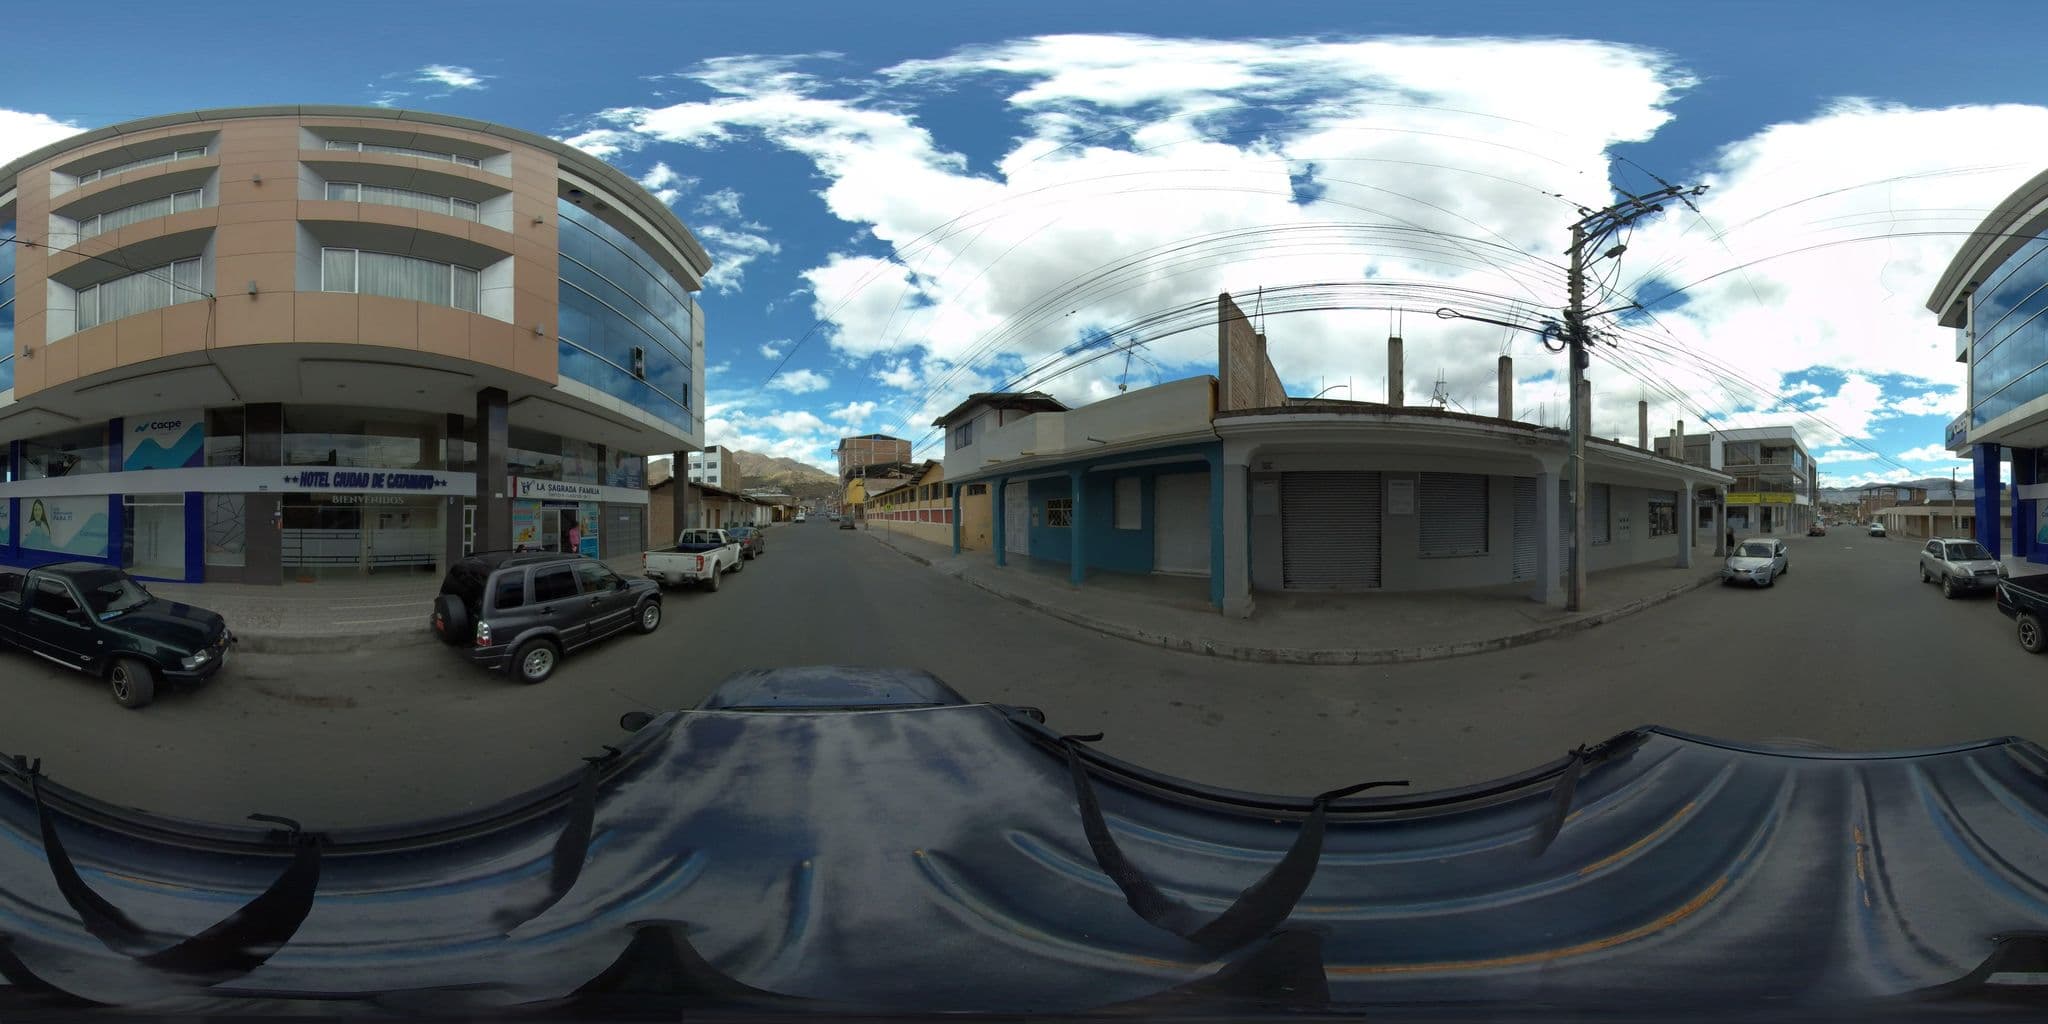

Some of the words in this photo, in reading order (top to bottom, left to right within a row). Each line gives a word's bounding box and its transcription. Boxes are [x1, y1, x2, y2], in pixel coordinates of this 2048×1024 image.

[151, 420, 182, 431] Cacpe
[299, 471, 330, 487] HOTEL
[333, 471, 369, 488] CIUDAD
[371, 473, 385, 489] DE
[536, 482, 546, 491] LA
[547, 483, 577, 493] SAGRADA
[578, 486, 600, 495] FAMILIA
[332, 495, 405, 505] BIENVENIDOS
